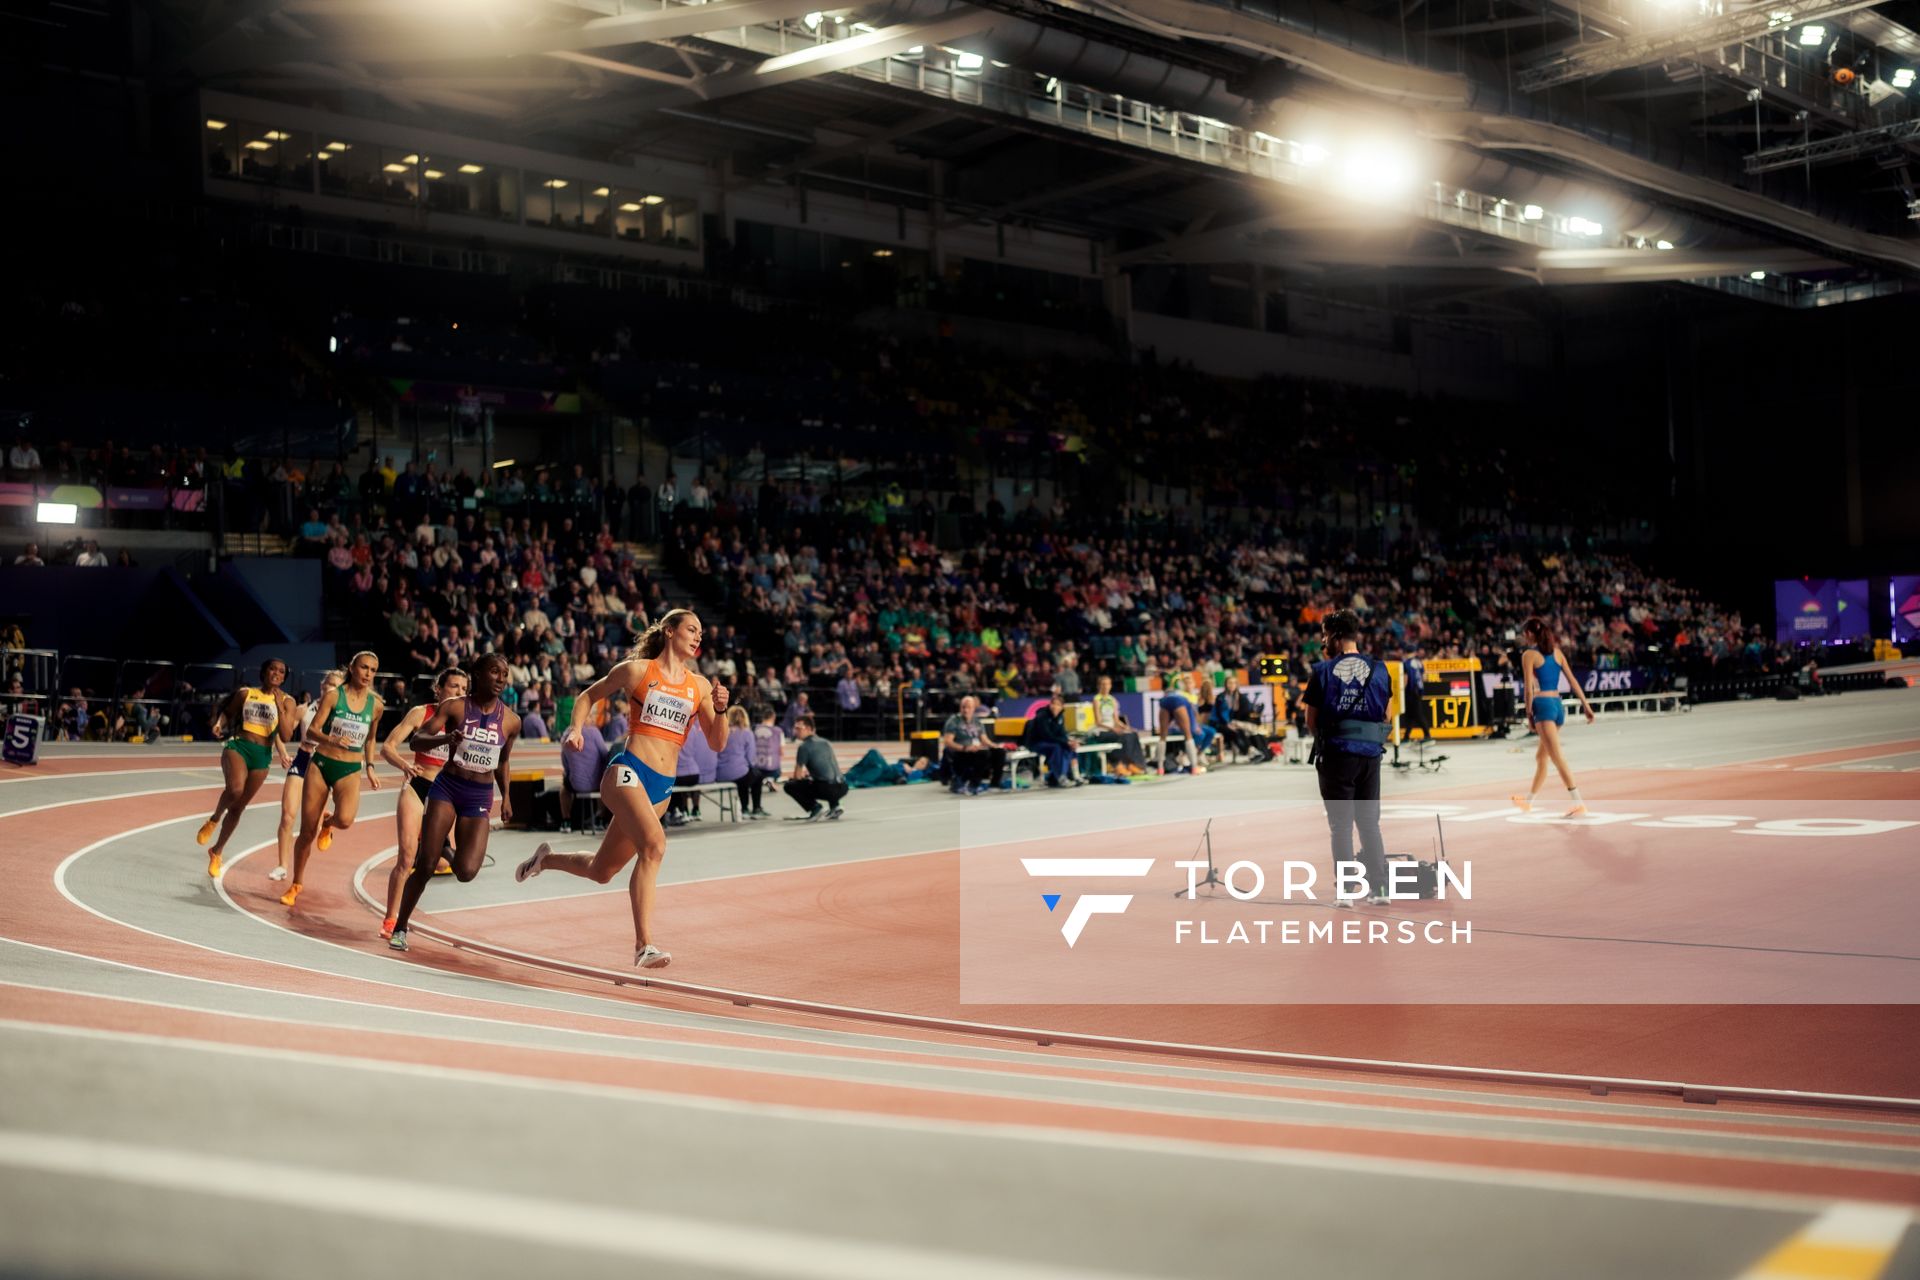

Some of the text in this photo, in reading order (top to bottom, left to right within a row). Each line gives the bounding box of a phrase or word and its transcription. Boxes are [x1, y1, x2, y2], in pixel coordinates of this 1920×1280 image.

[646, 703, 687, 724] KLAVER
[1429, 697, 1471, 728] 1.97
[11, 725, 30, 749] 5
[464, 725, 499, 744] USA
[462, 751, 492, 766] DIGGS
[622, 770, 632, 783] 5
